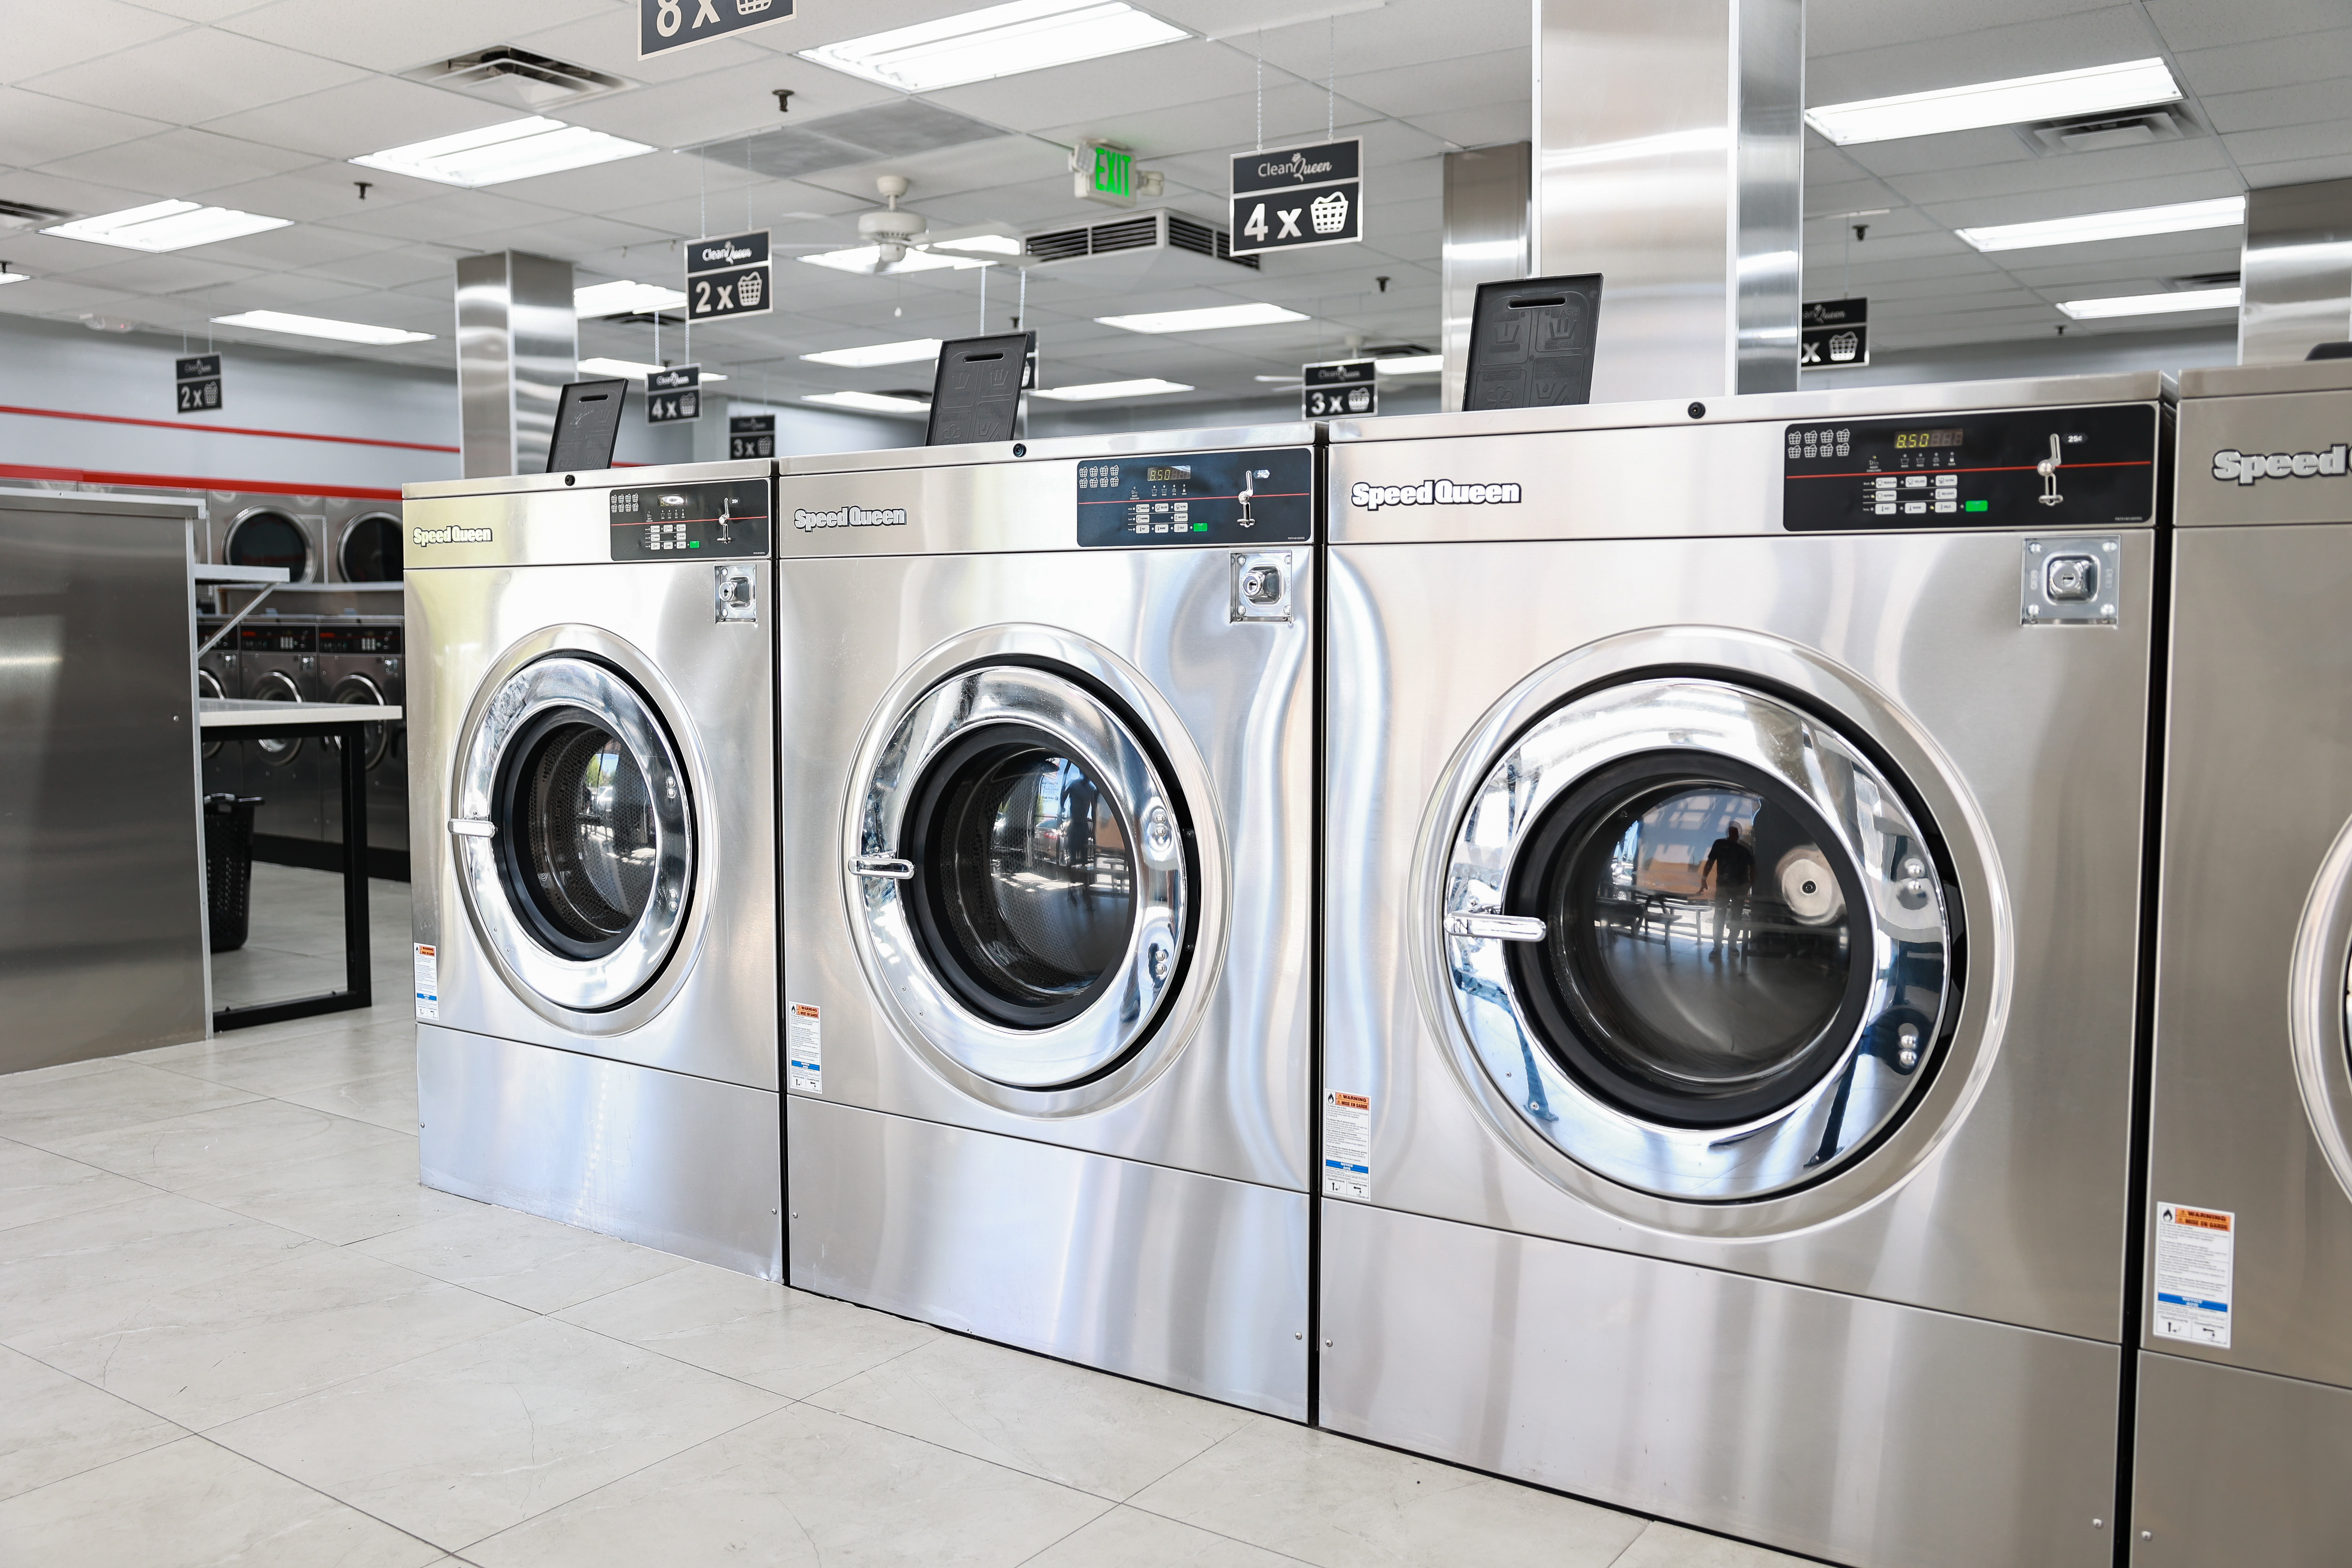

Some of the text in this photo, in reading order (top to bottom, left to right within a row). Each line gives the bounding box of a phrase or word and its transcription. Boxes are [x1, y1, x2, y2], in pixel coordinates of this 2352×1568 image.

[657, 0, 682, 37] 8
[1096, 147, 1131, 197] EXIT
[1244, 203, 1302, 242] 4 x
[695, 281, 734, 313] 2 x
[1493, 313, 1519, 322] WASH
[1551, 308, 1580, 318] WASH
[1484, 373, 1520, 381] SOFTENER
[181, 386, 203, 409] 2 x
[651, 397, 678, 419] 4 x
[1311, 392, 1344, 415] 3 x
[733, 438, 755, 457] 3 x
[1896, 434, 1929, 448] 8.50
[2212, 444, 2347, 486] Speed
[1343, 1094, 1366, 1102] WARNING
[2187, 1211, 2226, 1221] WARNING
